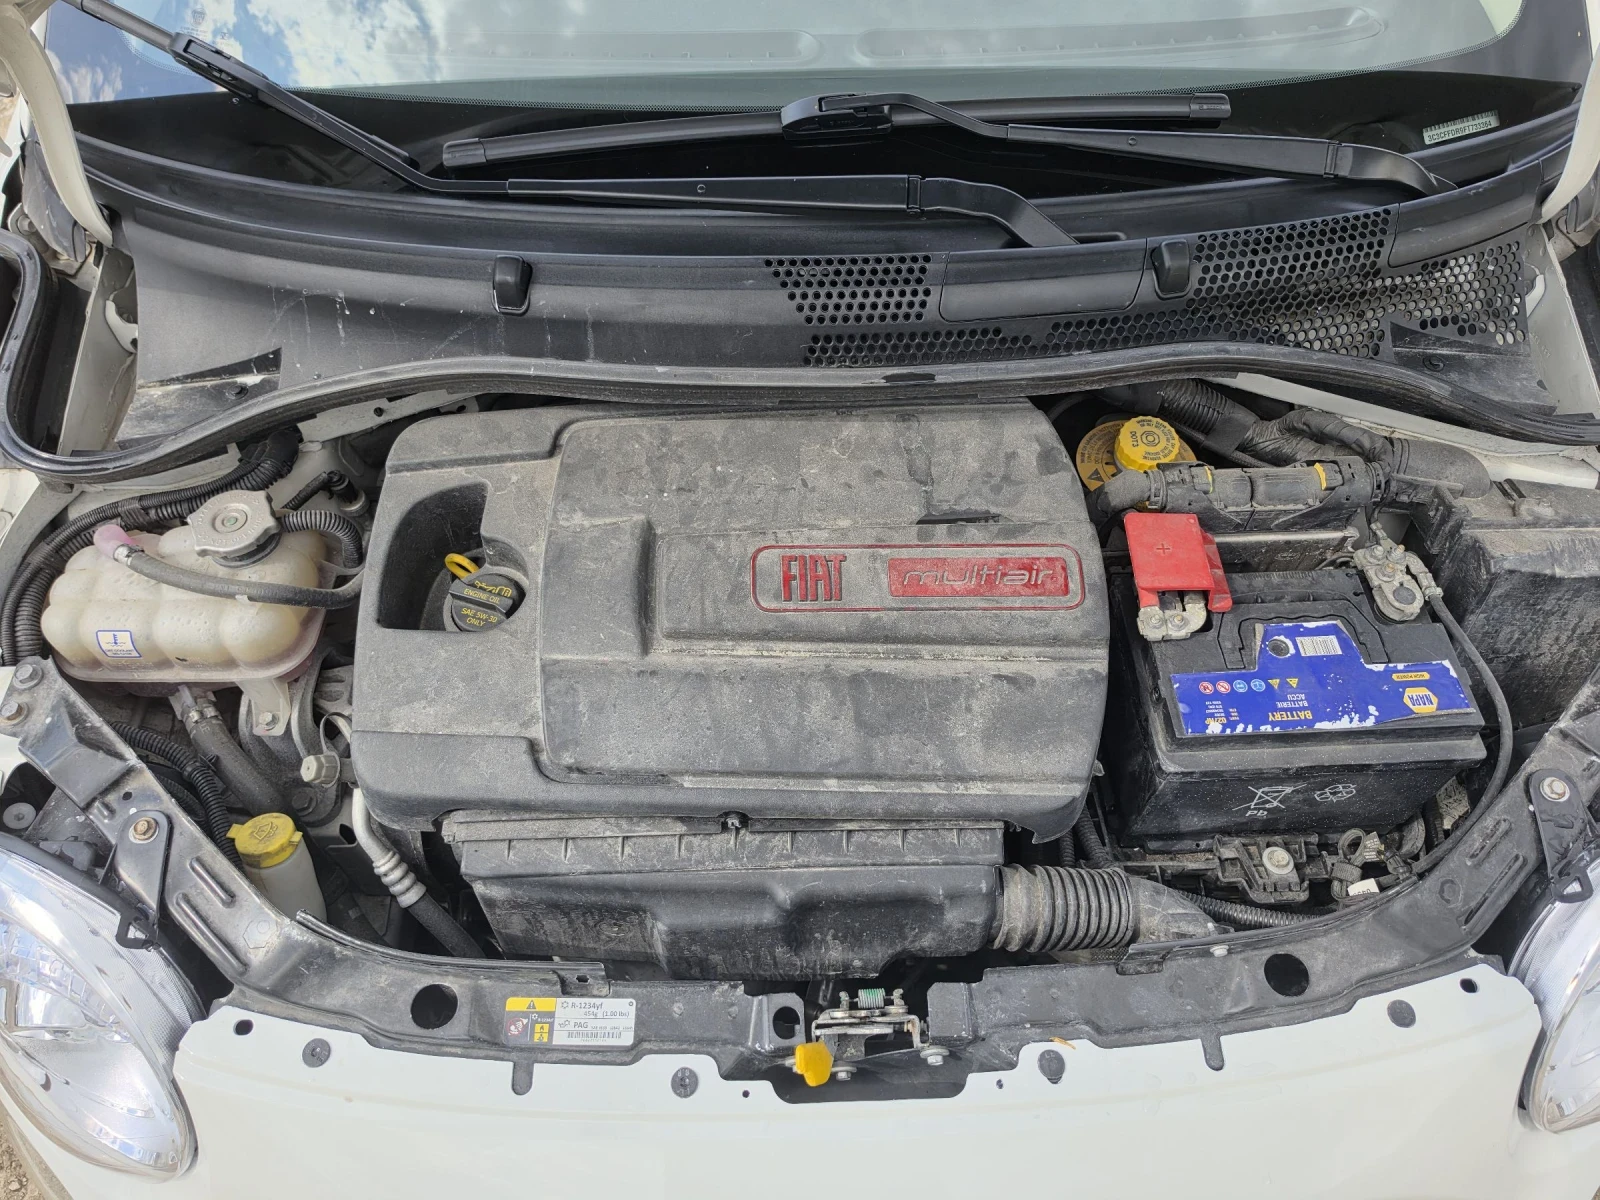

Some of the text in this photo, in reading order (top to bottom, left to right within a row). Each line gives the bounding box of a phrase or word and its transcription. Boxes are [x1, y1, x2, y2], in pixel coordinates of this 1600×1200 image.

[1427, 120, 1492, 142] 3C3CFFDR9FT733364
[781, 554, 847, 602] FIAT
[903, 565, 1053, 586] multiair
[463, 588, 500, 604] ENGINE OIL
[461, 607, 498, 623] SAE 5W-30
[466, 617, 486, 627] ONLY
[1287, 693, 1306, 701] ACCU
[1407, 694, 1434, 706] NAPA
[1276, 700, 1309, 708] BATTERIE
[1268, 710, 1312, 721] BATTERY
[1245, 809, 1268, 817] Pb
[571, 1002, 603, 1010] R-1234yf
[583, 1010, 598, 1018] 454g
[602, 1010, 617, 1018] (1.00
[573, 1021, 588, 1029] PAG
